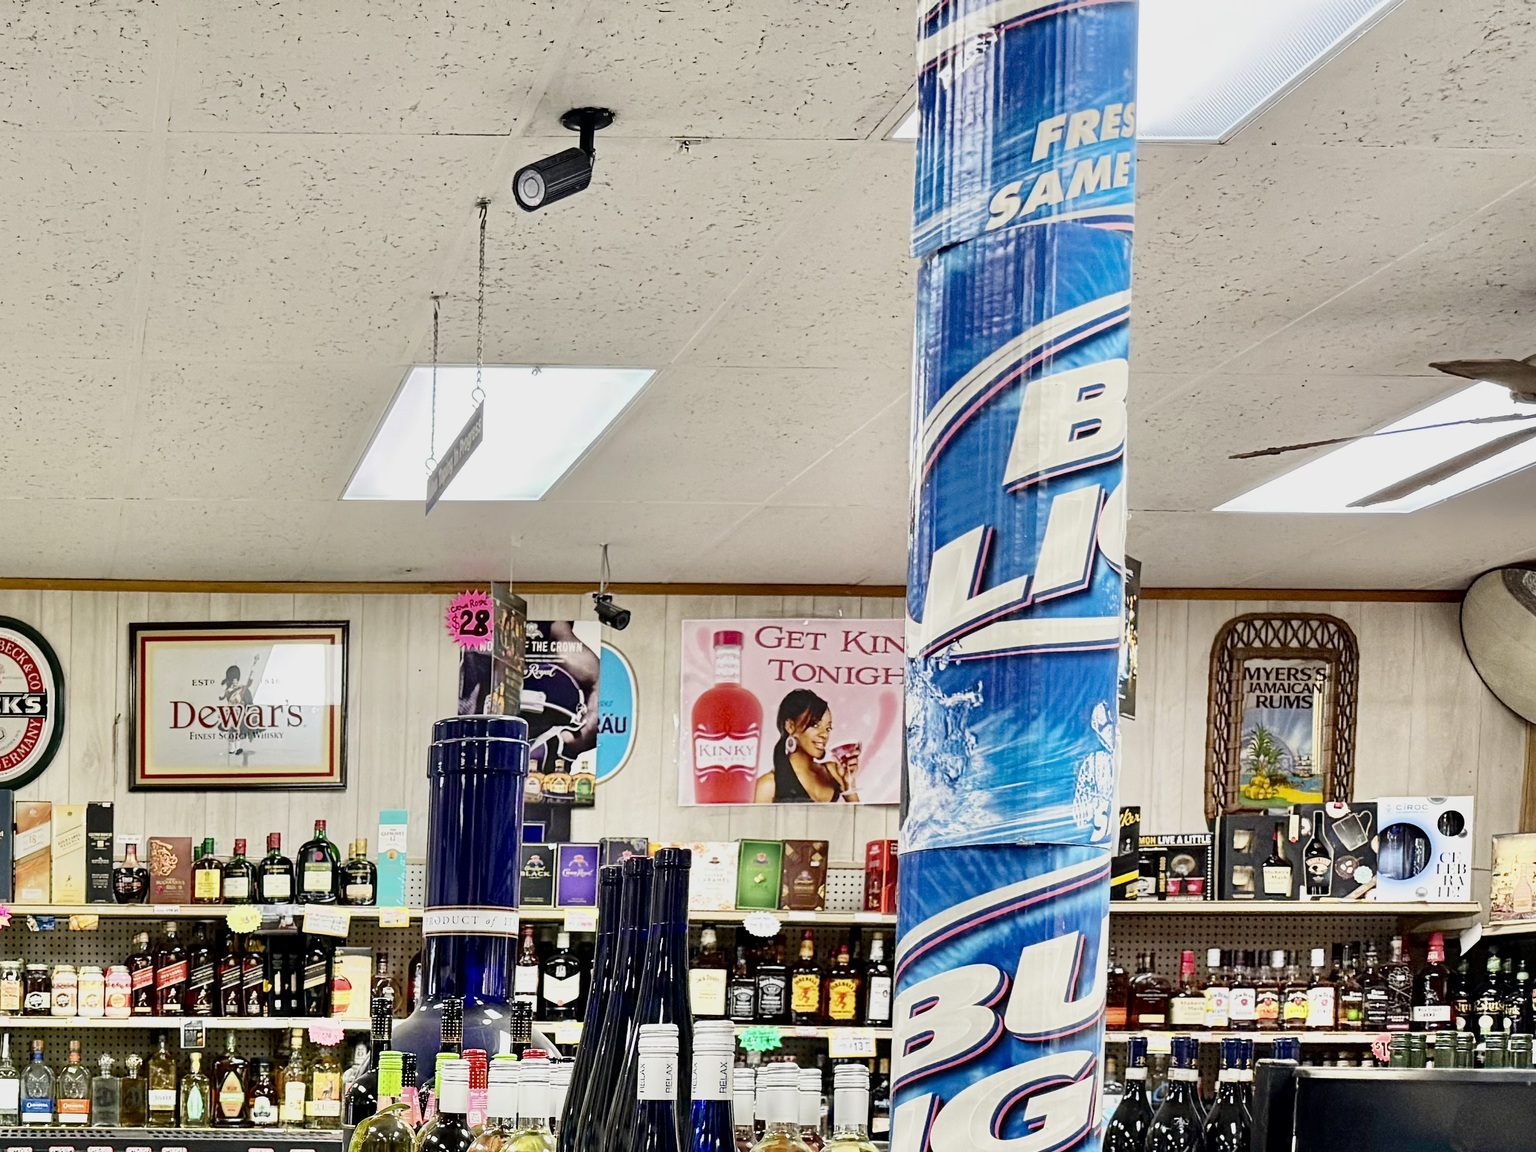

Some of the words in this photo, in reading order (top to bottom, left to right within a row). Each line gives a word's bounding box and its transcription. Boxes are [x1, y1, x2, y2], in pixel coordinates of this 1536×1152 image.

[985, 152, 1131, 231] SAME
[755, 625, 827, 651] GET
[532, 641, 549, 652] THE
[550, 641, 583, 653] CROWN
[1247, 682, 1323, 695] JAMAICAN
[1256, 695, 1313, 709] RUMS
[170, 700, 303, 729] Dewar's
[699, 744, 754, 757] KINKY
[1157, 836, 1175, 845] LIVE
[1184, 834, 1211, 844] LITTLE
[485, 915, 498, 926] of
[719, 1061, 728, 1094] RELAX
